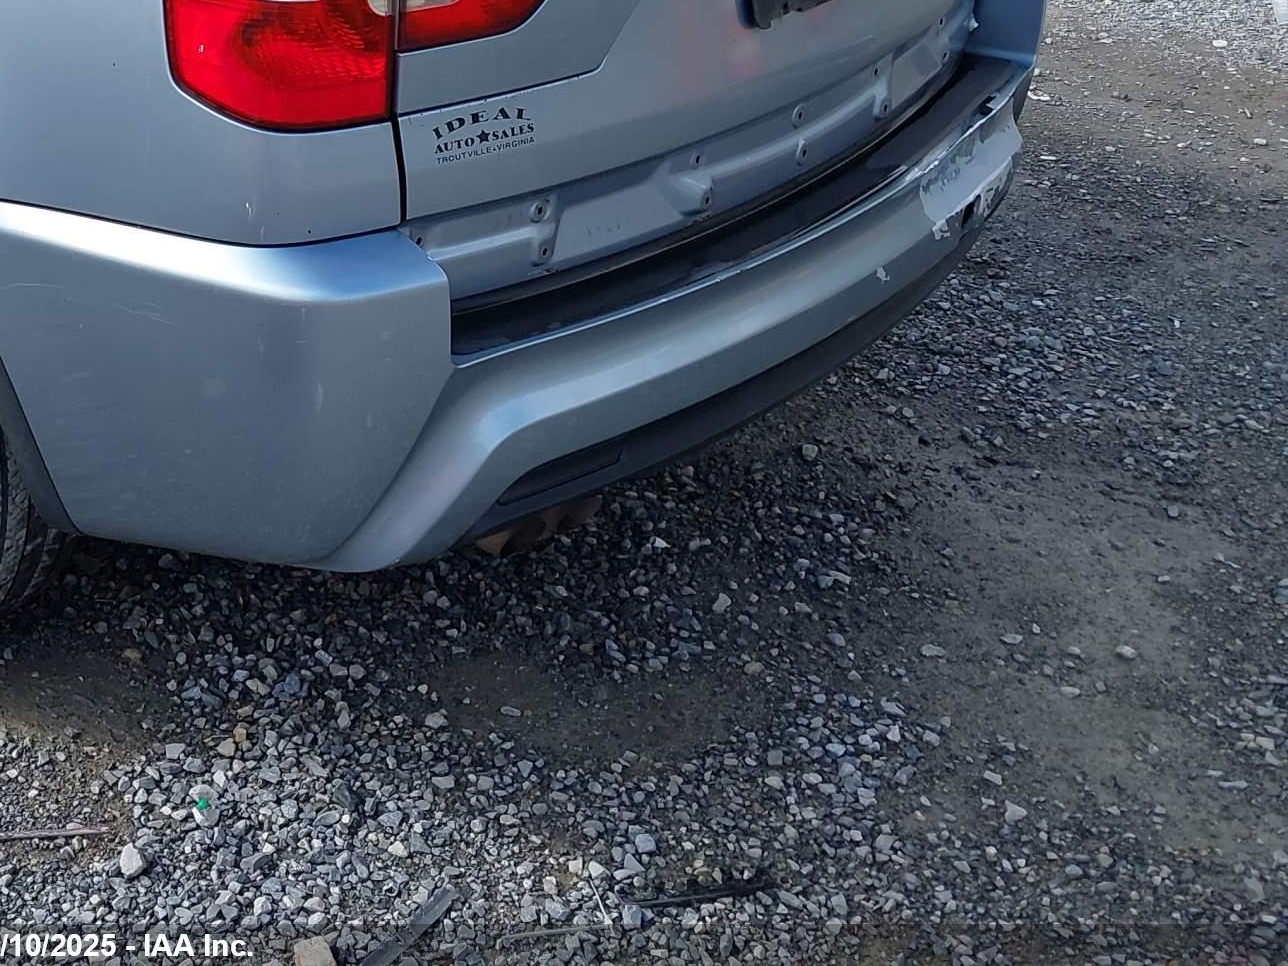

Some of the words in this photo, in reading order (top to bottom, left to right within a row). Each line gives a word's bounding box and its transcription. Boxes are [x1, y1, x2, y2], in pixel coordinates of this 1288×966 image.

[431, 106, 533, 140] IDEAL
[433, 136, 475, 155] AUTO
[491, 122, 535, 142] SALES
